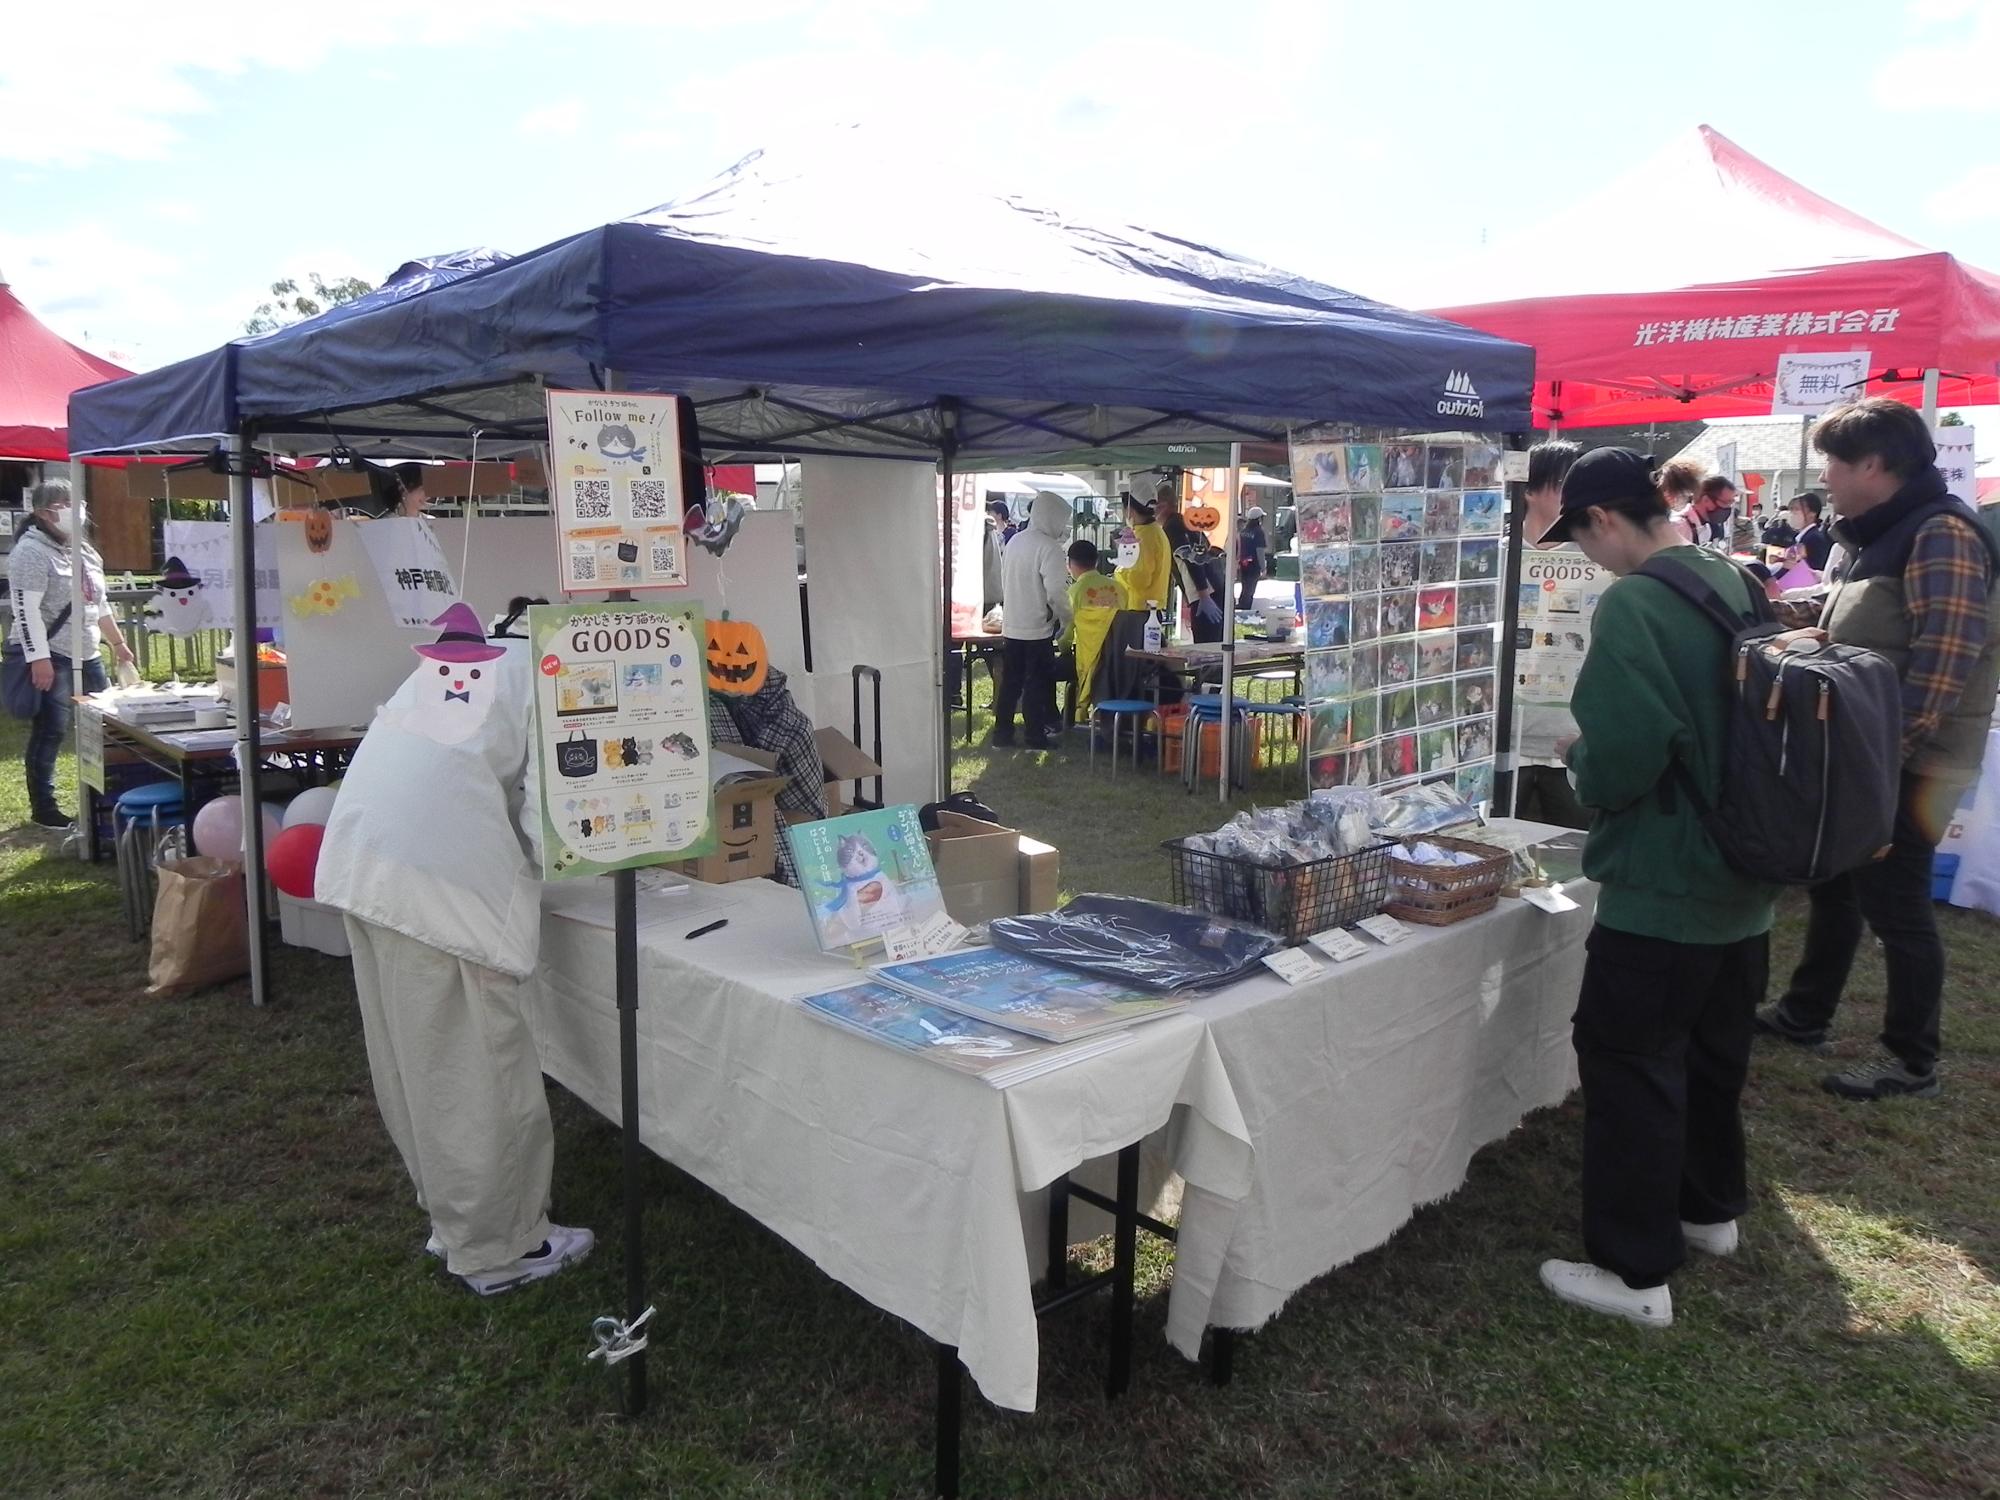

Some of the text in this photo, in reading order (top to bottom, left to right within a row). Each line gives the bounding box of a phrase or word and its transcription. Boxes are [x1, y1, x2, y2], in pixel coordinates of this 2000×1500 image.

[1633, 308, 1900, 346] 光洋機械産業株式会社
[1798, 374, 1840, 394] 無料
[575, 408, 622, 422] Follow
[628, 413, 646, 423] me
[1167, 444, 1198, 454] outrich
[1529, 565, 1596, 581] GOODS
[572, 627, 671, 653] GOODS
